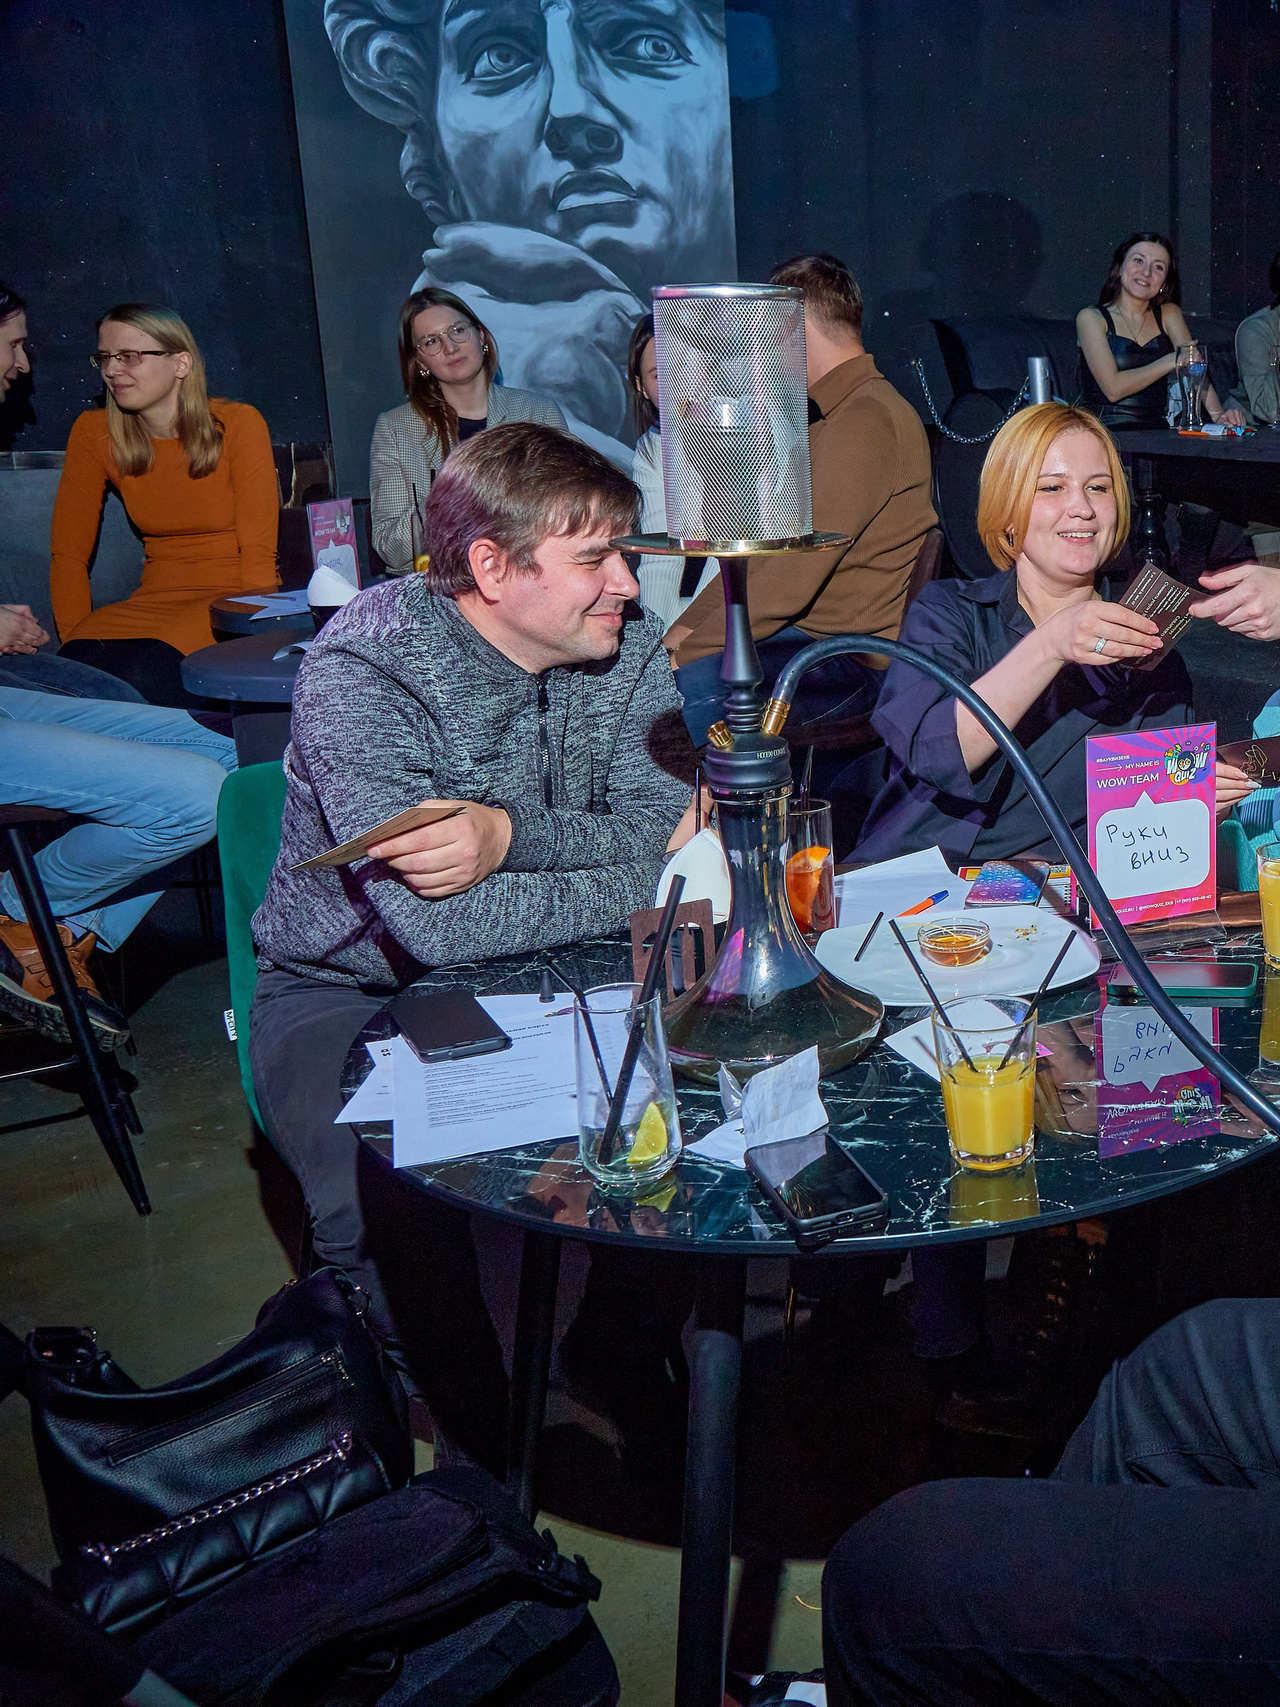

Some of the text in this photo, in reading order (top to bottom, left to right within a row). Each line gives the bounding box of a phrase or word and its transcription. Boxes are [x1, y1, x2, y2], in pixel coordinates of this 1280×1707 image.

[1097, 773, 1160, 789] WOW TEAM
[1174, 768, 1197, 783] QUIZ
[1106, 824, 1168, 847] Руки
